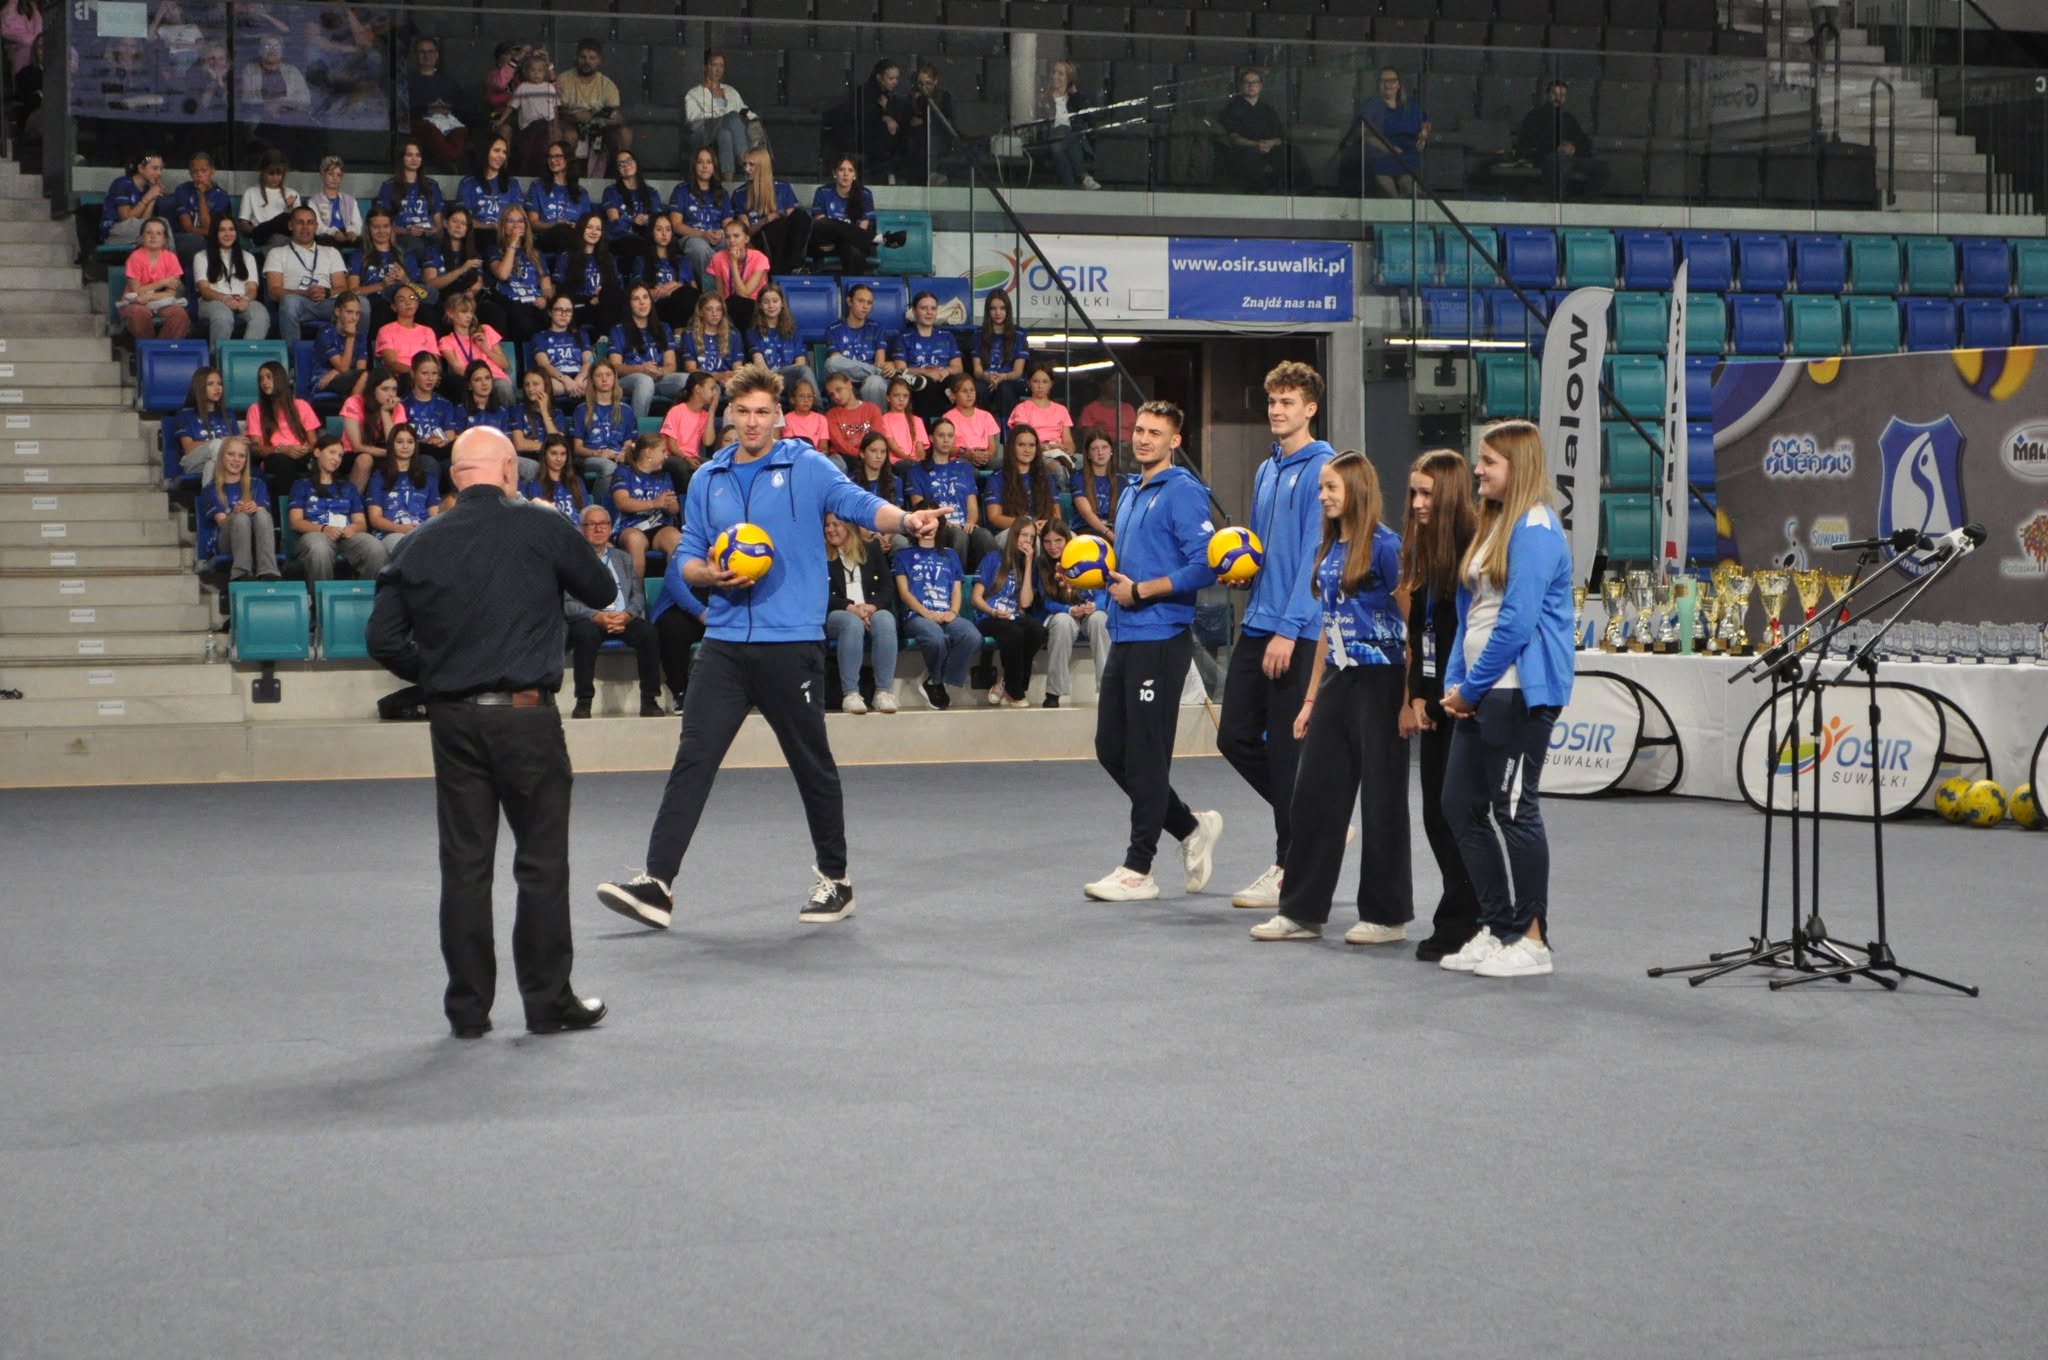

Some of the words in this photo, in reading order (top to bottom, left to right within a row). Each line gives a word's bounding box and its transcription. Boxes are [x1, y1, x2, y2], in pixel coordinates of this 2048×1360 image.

[1172, 256, 1345, 277] www.osir.suwalki.pl
[1029, 265, 1108, 292] OSIR
[1031, 296, 1109, 306] SUWŁKI
[1242, 296, 1281, 310] Znajdź
[1284, 299, 1305, 308] nas
[1307, 300, 1322, 309] na
[1556, 312, 1589, 531] Malow
[2013, 443, 2048, 460] MAL
[804, 691, 811, 703] 1
[1139, 689, 1155, 702] 10
[1548, 721, 1615, 753] OSIR
[1837, 737, 1912, 770] OSIR
[1832, 771, 1907, 787] SUWŁKI
